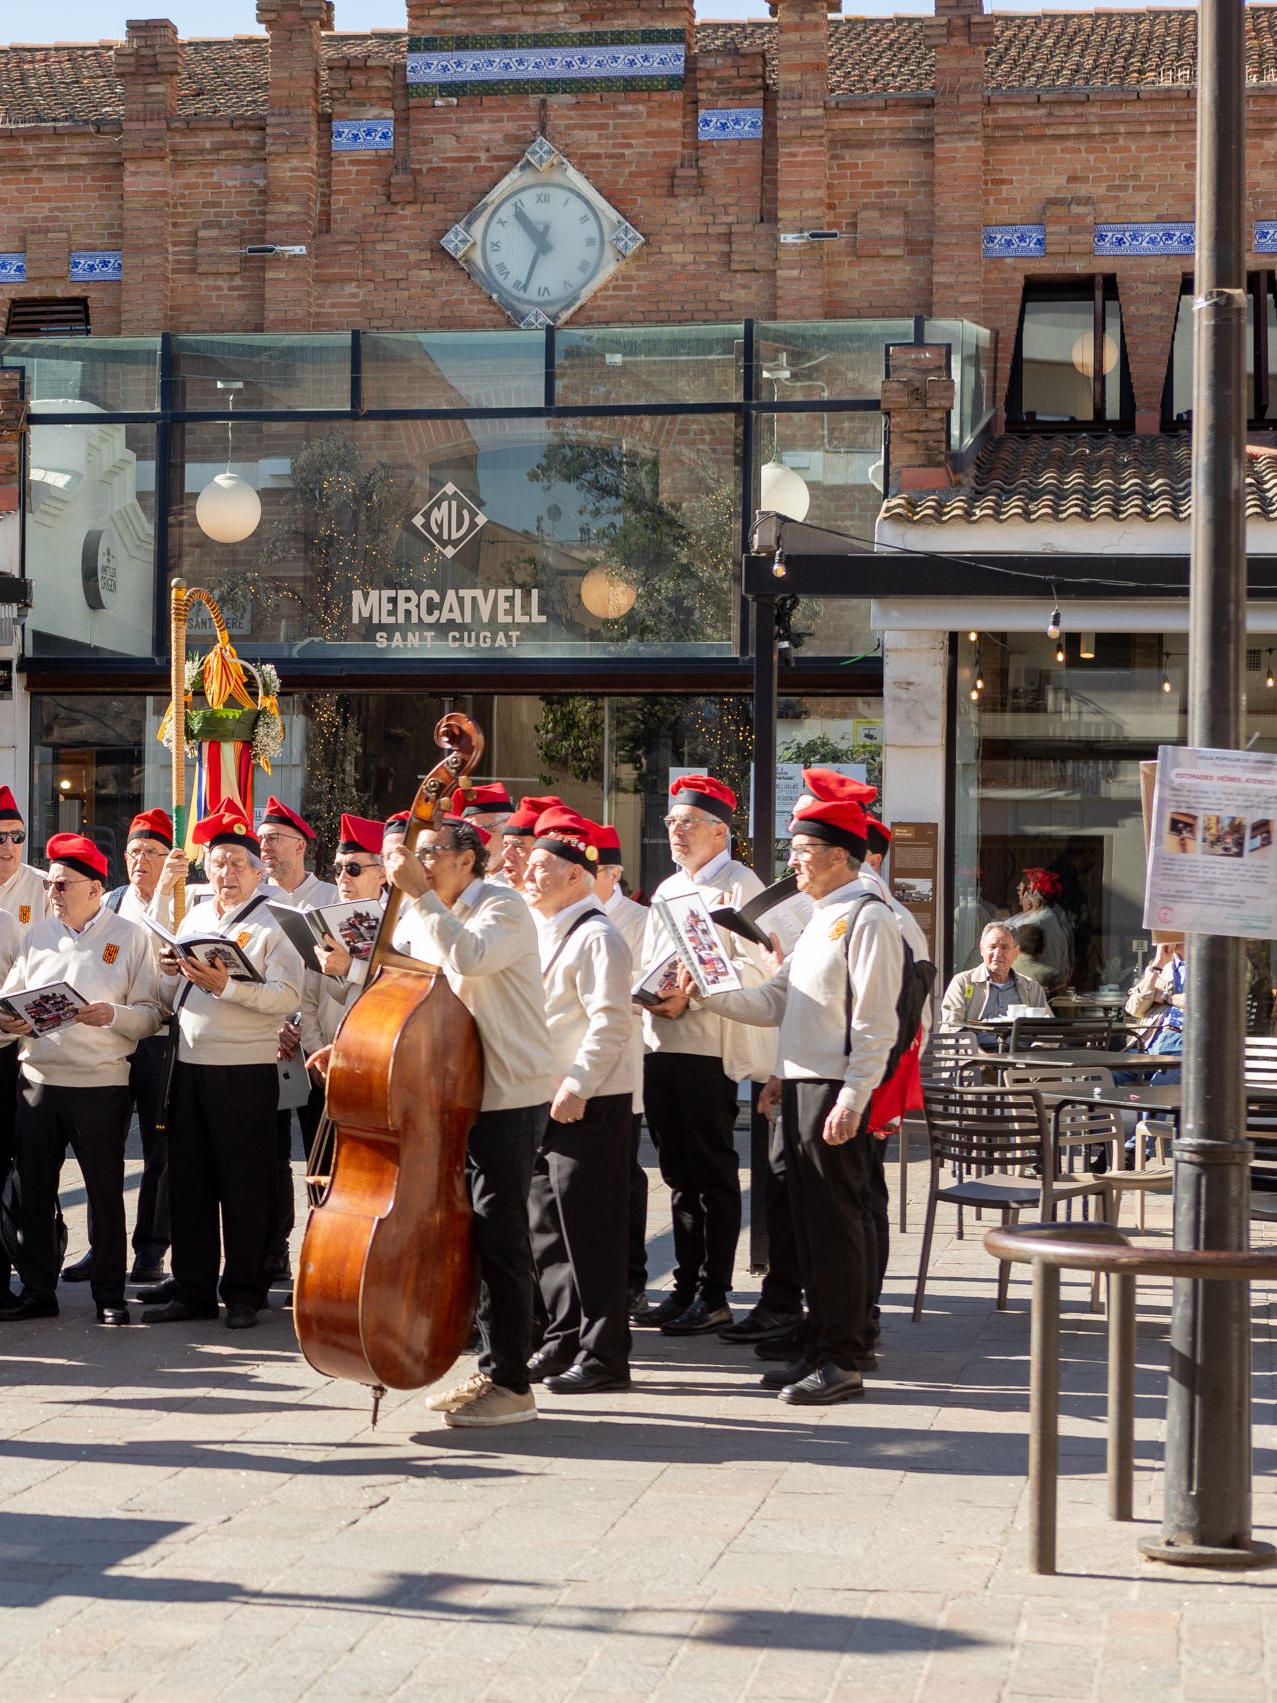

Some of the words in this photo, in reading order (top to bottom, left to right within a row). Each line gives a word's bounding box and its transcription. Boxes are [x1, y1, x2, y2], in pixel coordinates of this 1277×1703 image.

[536, 193, 551, 204] XII
[496, 217, 508, 229] X
[537, 286, 551, 297] VI
[101, 575, 117, 592] ORIGEN
[352, 588, 547, 624] MERCATVELL
[187, 617, 213, 630] SANT
[375, 631, 435, 648] SANT
[448, 631, 521, 648] CUGAT
